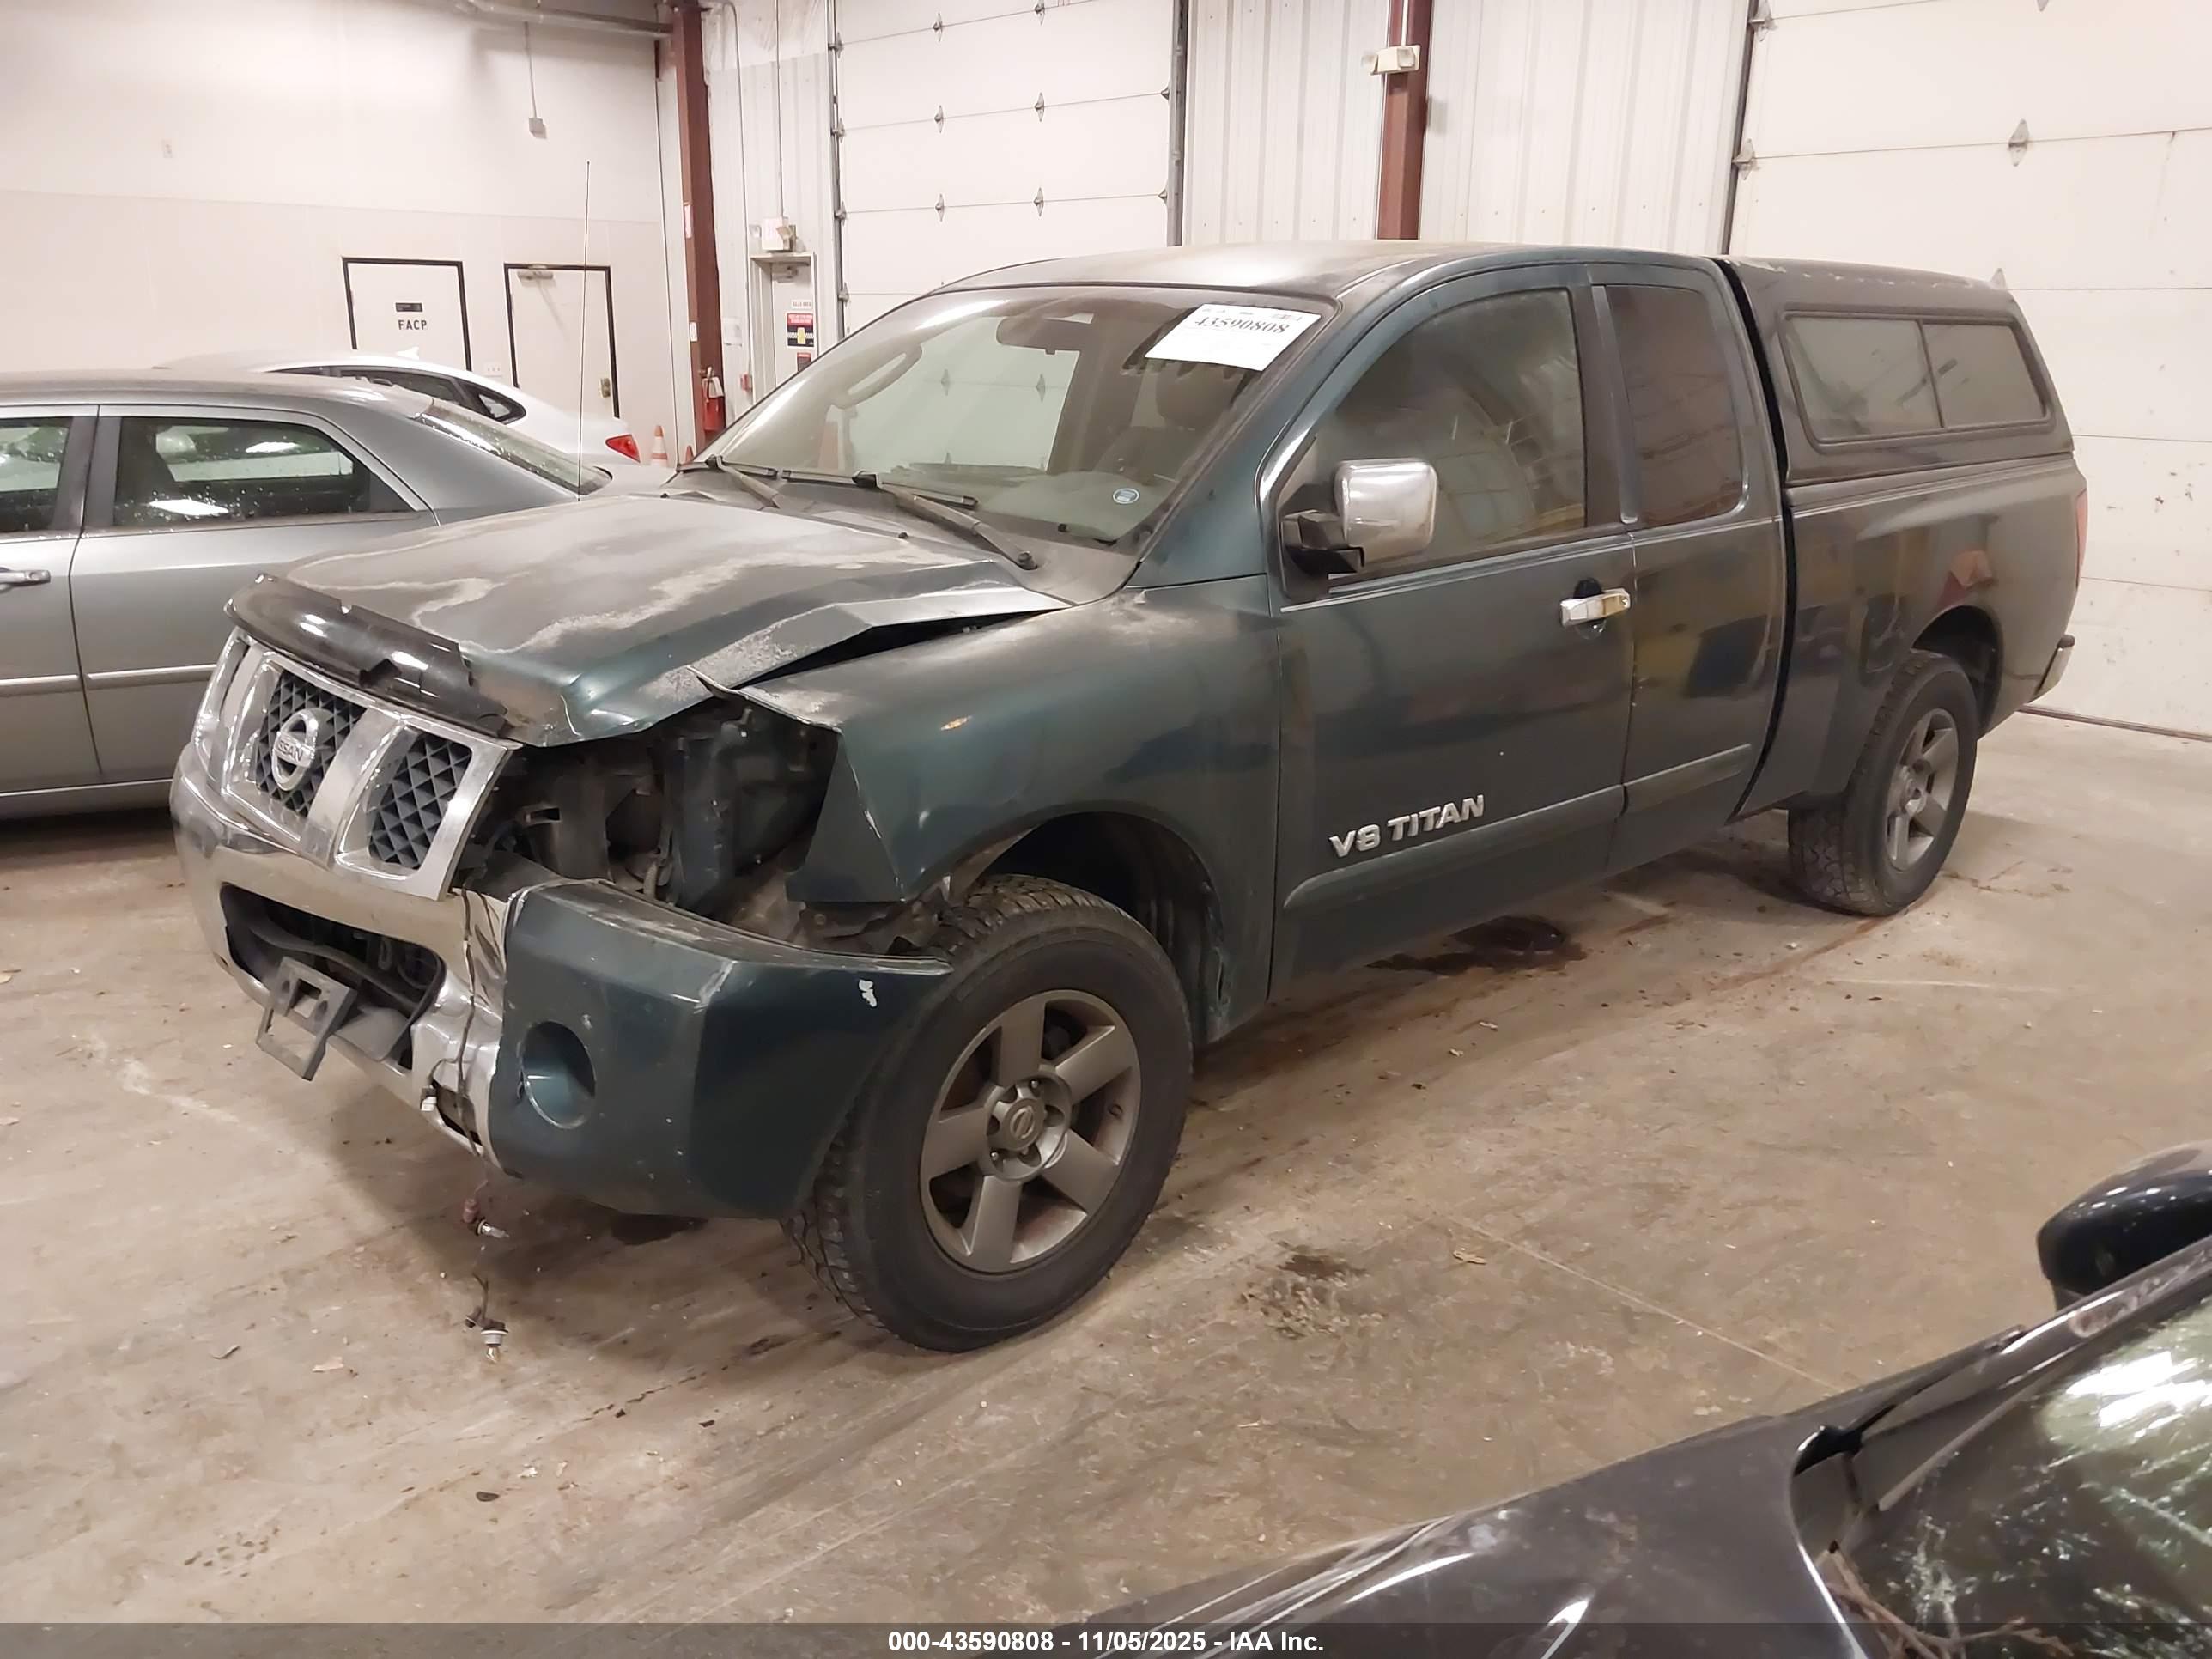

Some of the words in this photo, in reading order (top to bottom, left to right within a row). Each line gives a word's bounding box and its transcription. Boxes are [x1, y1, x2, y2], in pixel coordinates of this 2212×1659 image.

[398, 319, 427, 331] FACP
[1194, 316, 1291, 334] 43590808
[276, 738, 305, 763] SSAN
[1328, 823, 1381, 858] V8
[1387, 794, 1485, 842] TITAN
